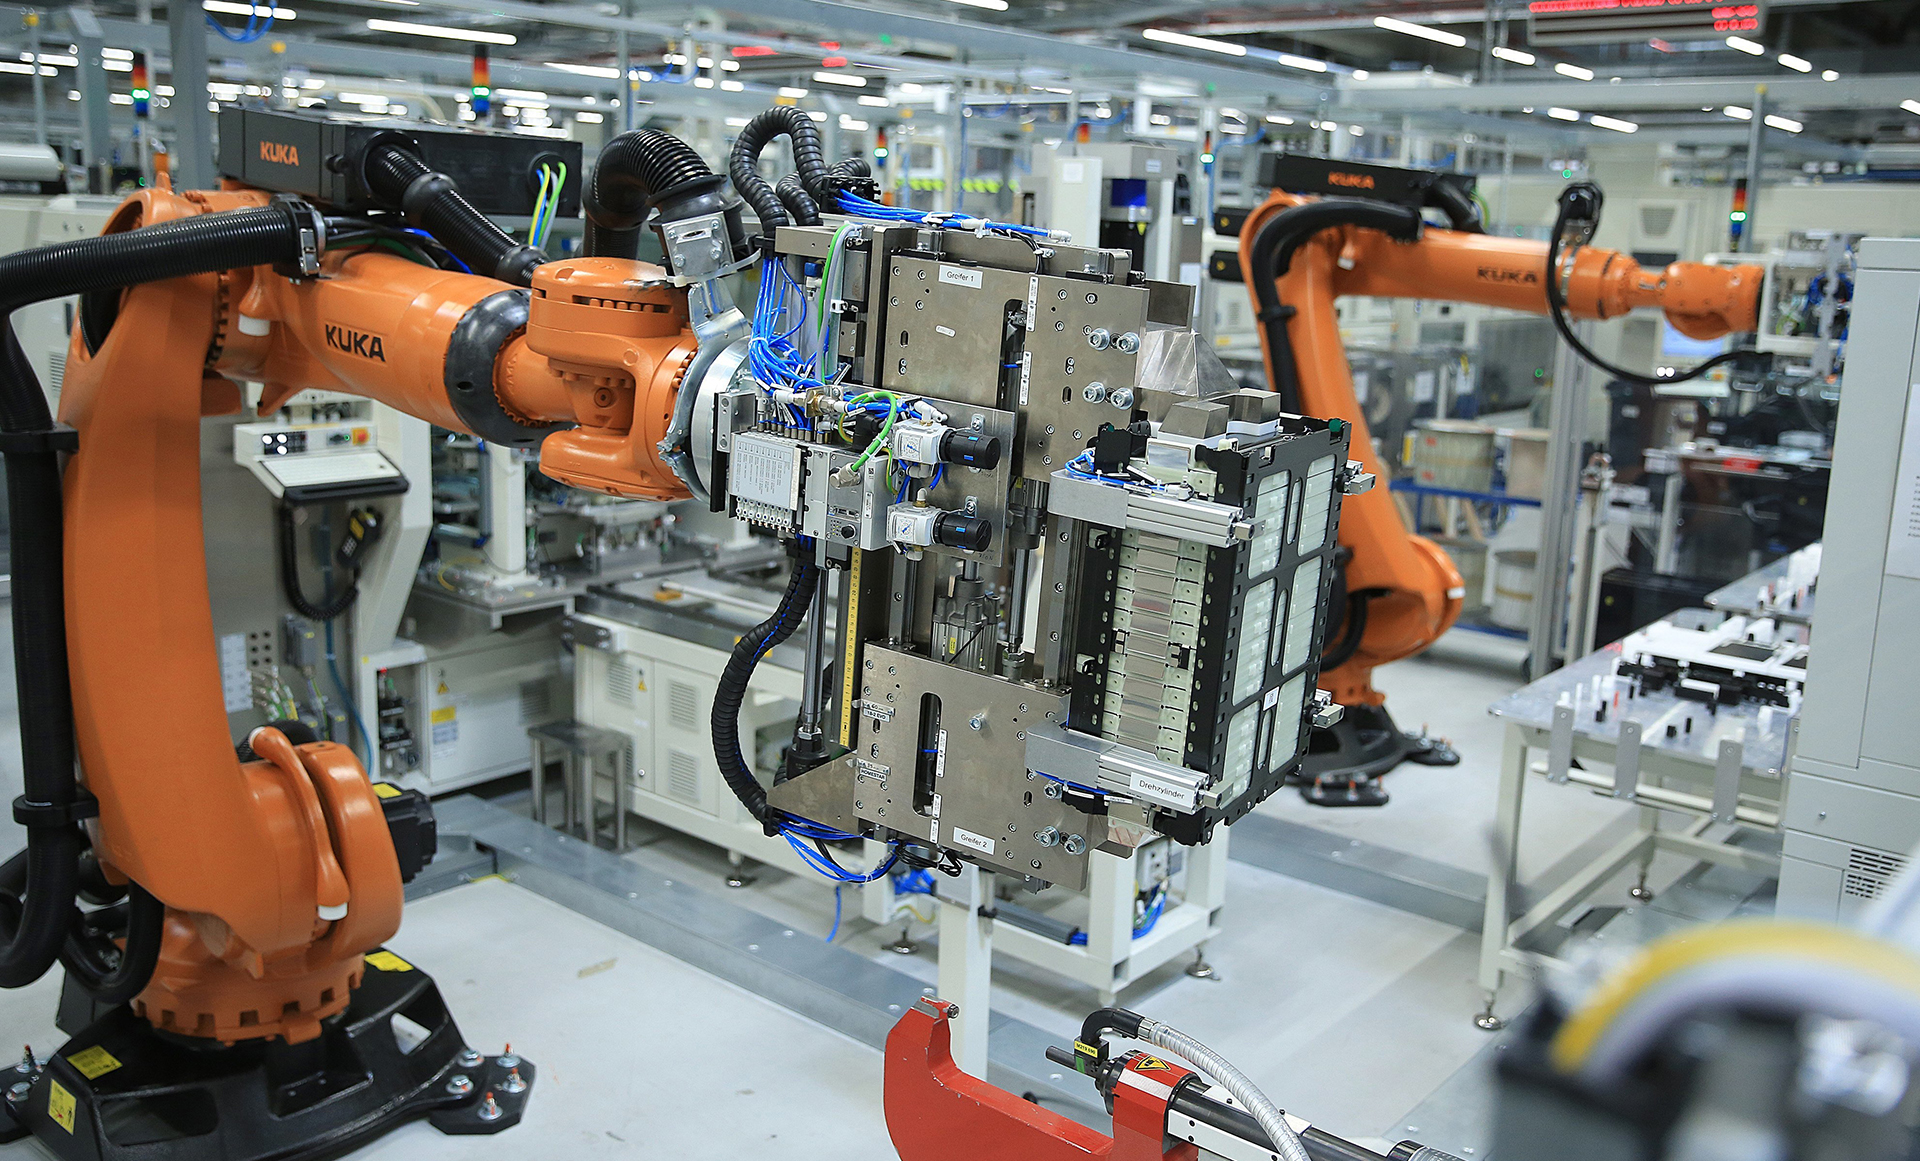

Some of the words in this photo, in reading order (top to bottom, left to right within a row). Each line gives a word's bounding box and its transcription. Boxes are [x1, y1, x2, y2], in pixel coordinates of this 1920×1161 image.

[260, 141, 299, 167] KUKA
[1328, 171, 1375, 190] KUKA
[946, 271, 969, 281] Greifer
[1477, 266, 1538, 284] KUKA
[325, 324, 386, 362] KUKA
[1139, 779, 1186, 800] Drehzylinder
[960, 833, 982, 846] Greifer
